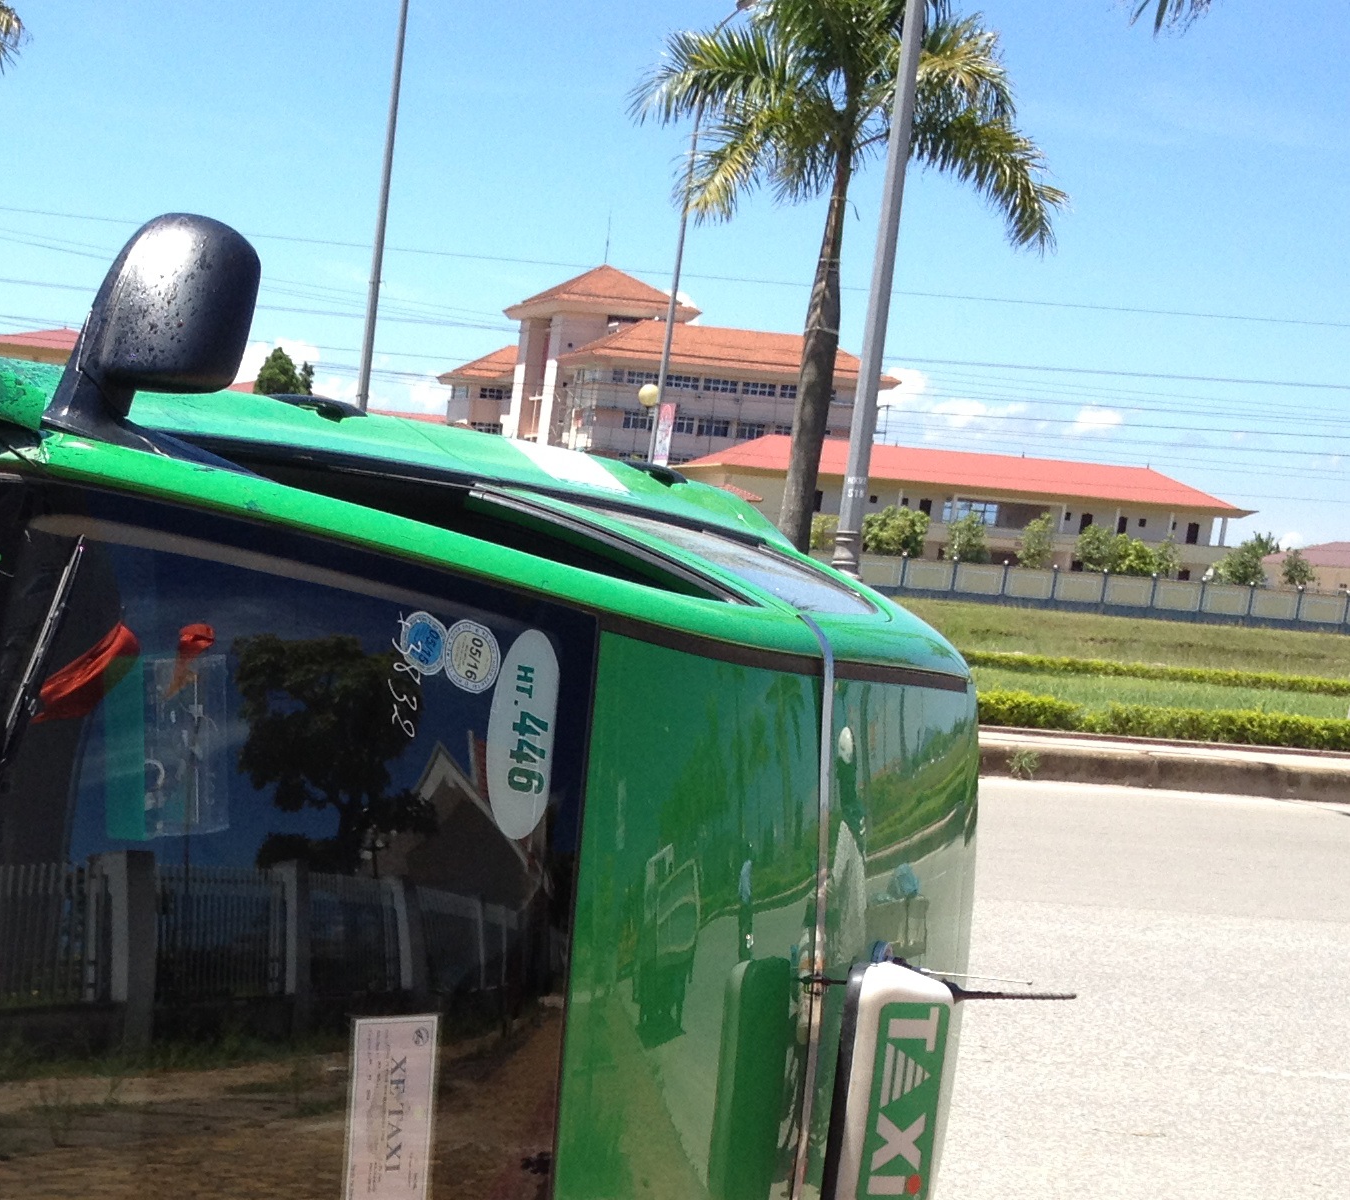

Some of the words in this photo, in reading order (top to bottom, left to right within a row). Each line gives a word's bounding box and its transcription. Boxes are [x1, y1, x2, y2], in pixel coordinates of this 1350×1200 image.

[465, 637, 484, 681] 05/16
[389, 1056, 407, 1095] XE
[385, 1103, 404, 1172] TAXI
